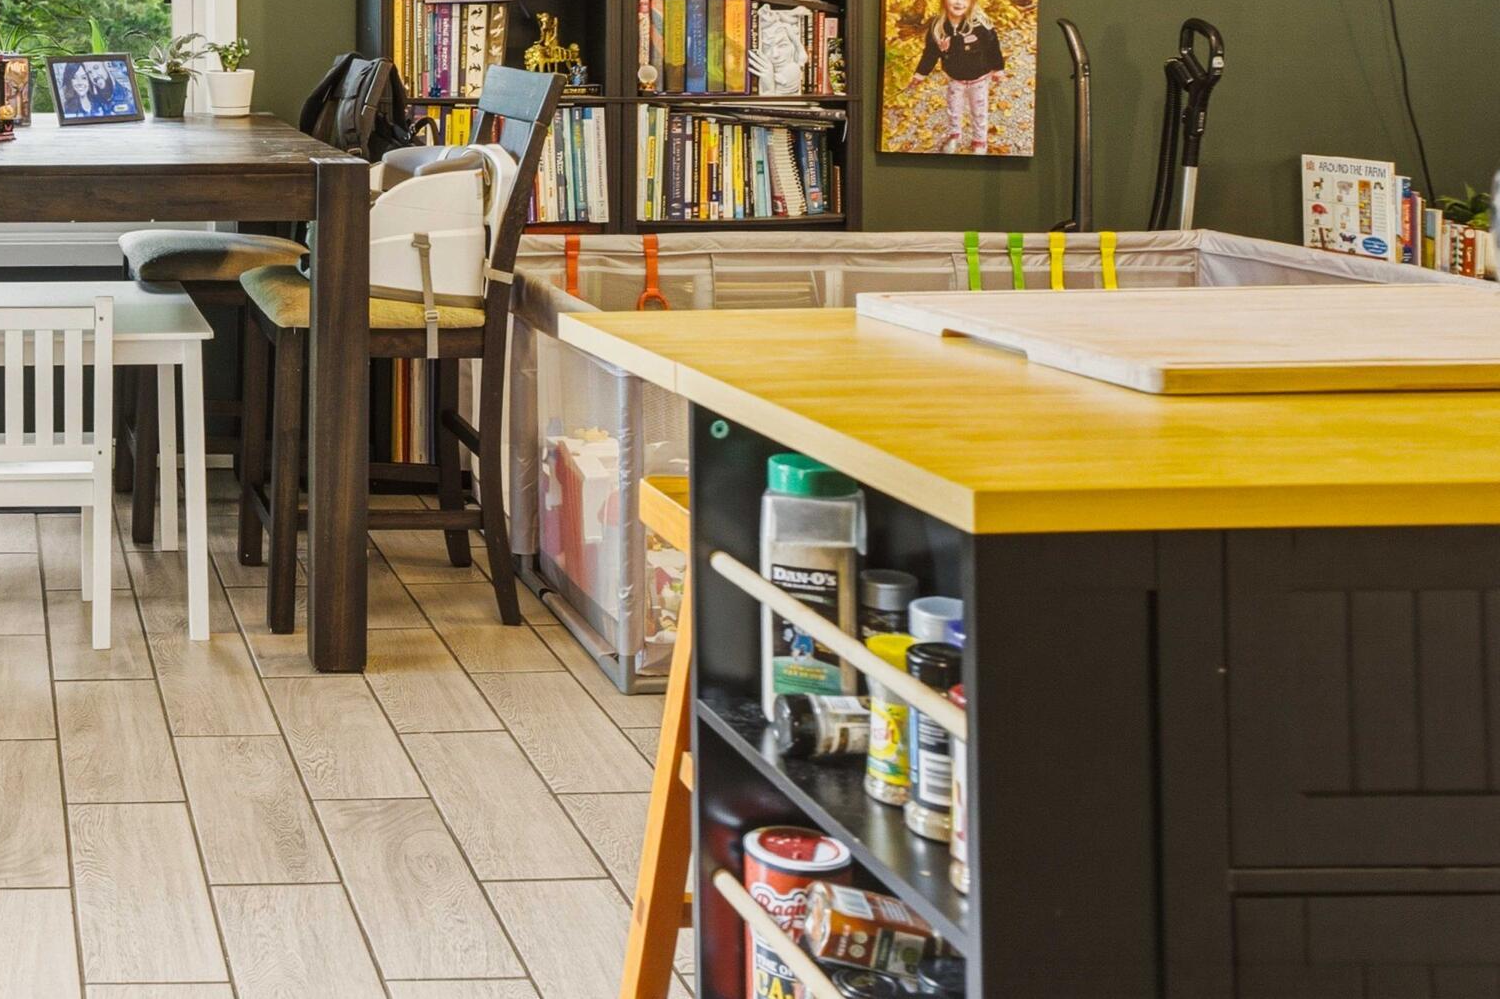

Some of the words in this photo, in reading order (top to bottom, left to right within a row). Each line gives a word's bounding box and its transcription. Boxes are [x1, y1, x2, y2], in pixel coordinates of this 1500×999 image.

[1318, 161, 1349, 174] AROUND
[1349, 164, 1363, 176] THE
[1364, 165, 1387, 179] FARM
